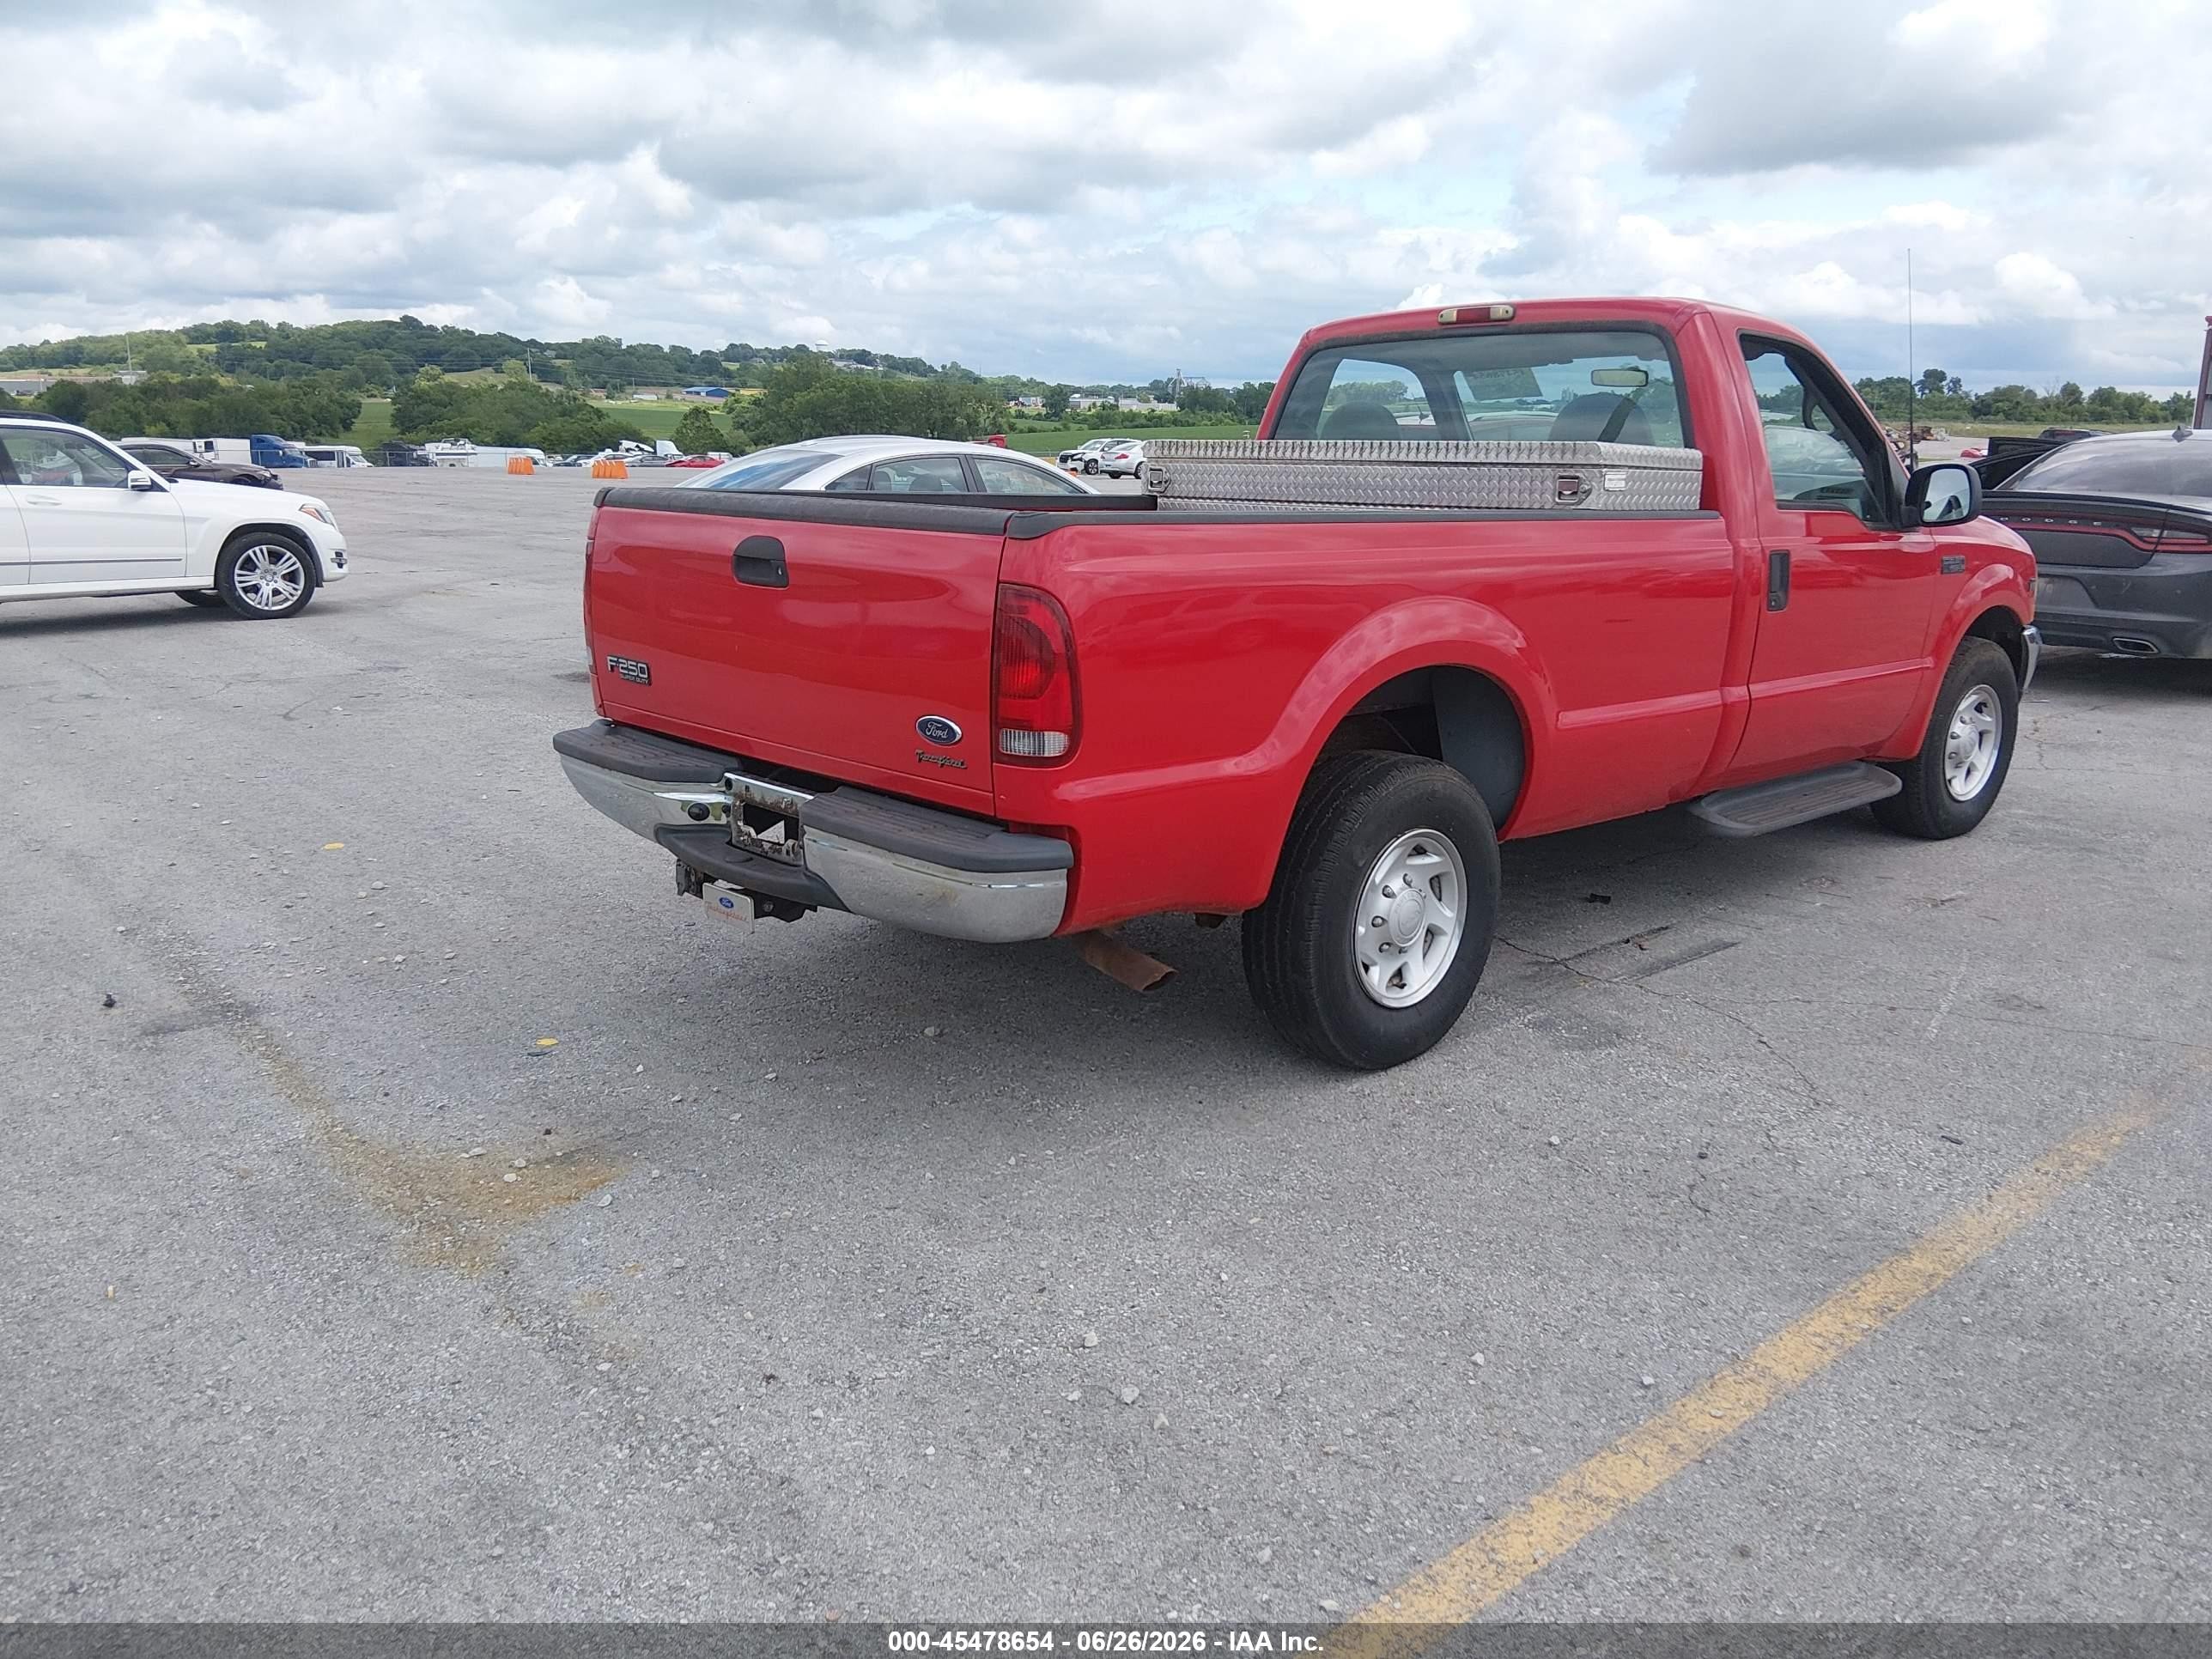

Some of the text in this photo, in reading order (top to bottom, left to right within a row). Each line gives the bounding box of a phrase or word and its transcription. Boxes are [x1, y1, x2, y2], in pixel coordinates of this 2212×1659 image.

[2000, 517, 2102, 526] DODGE
[606, 655, 648, 678] F-250
[926, 721, 949, 738] Ford
